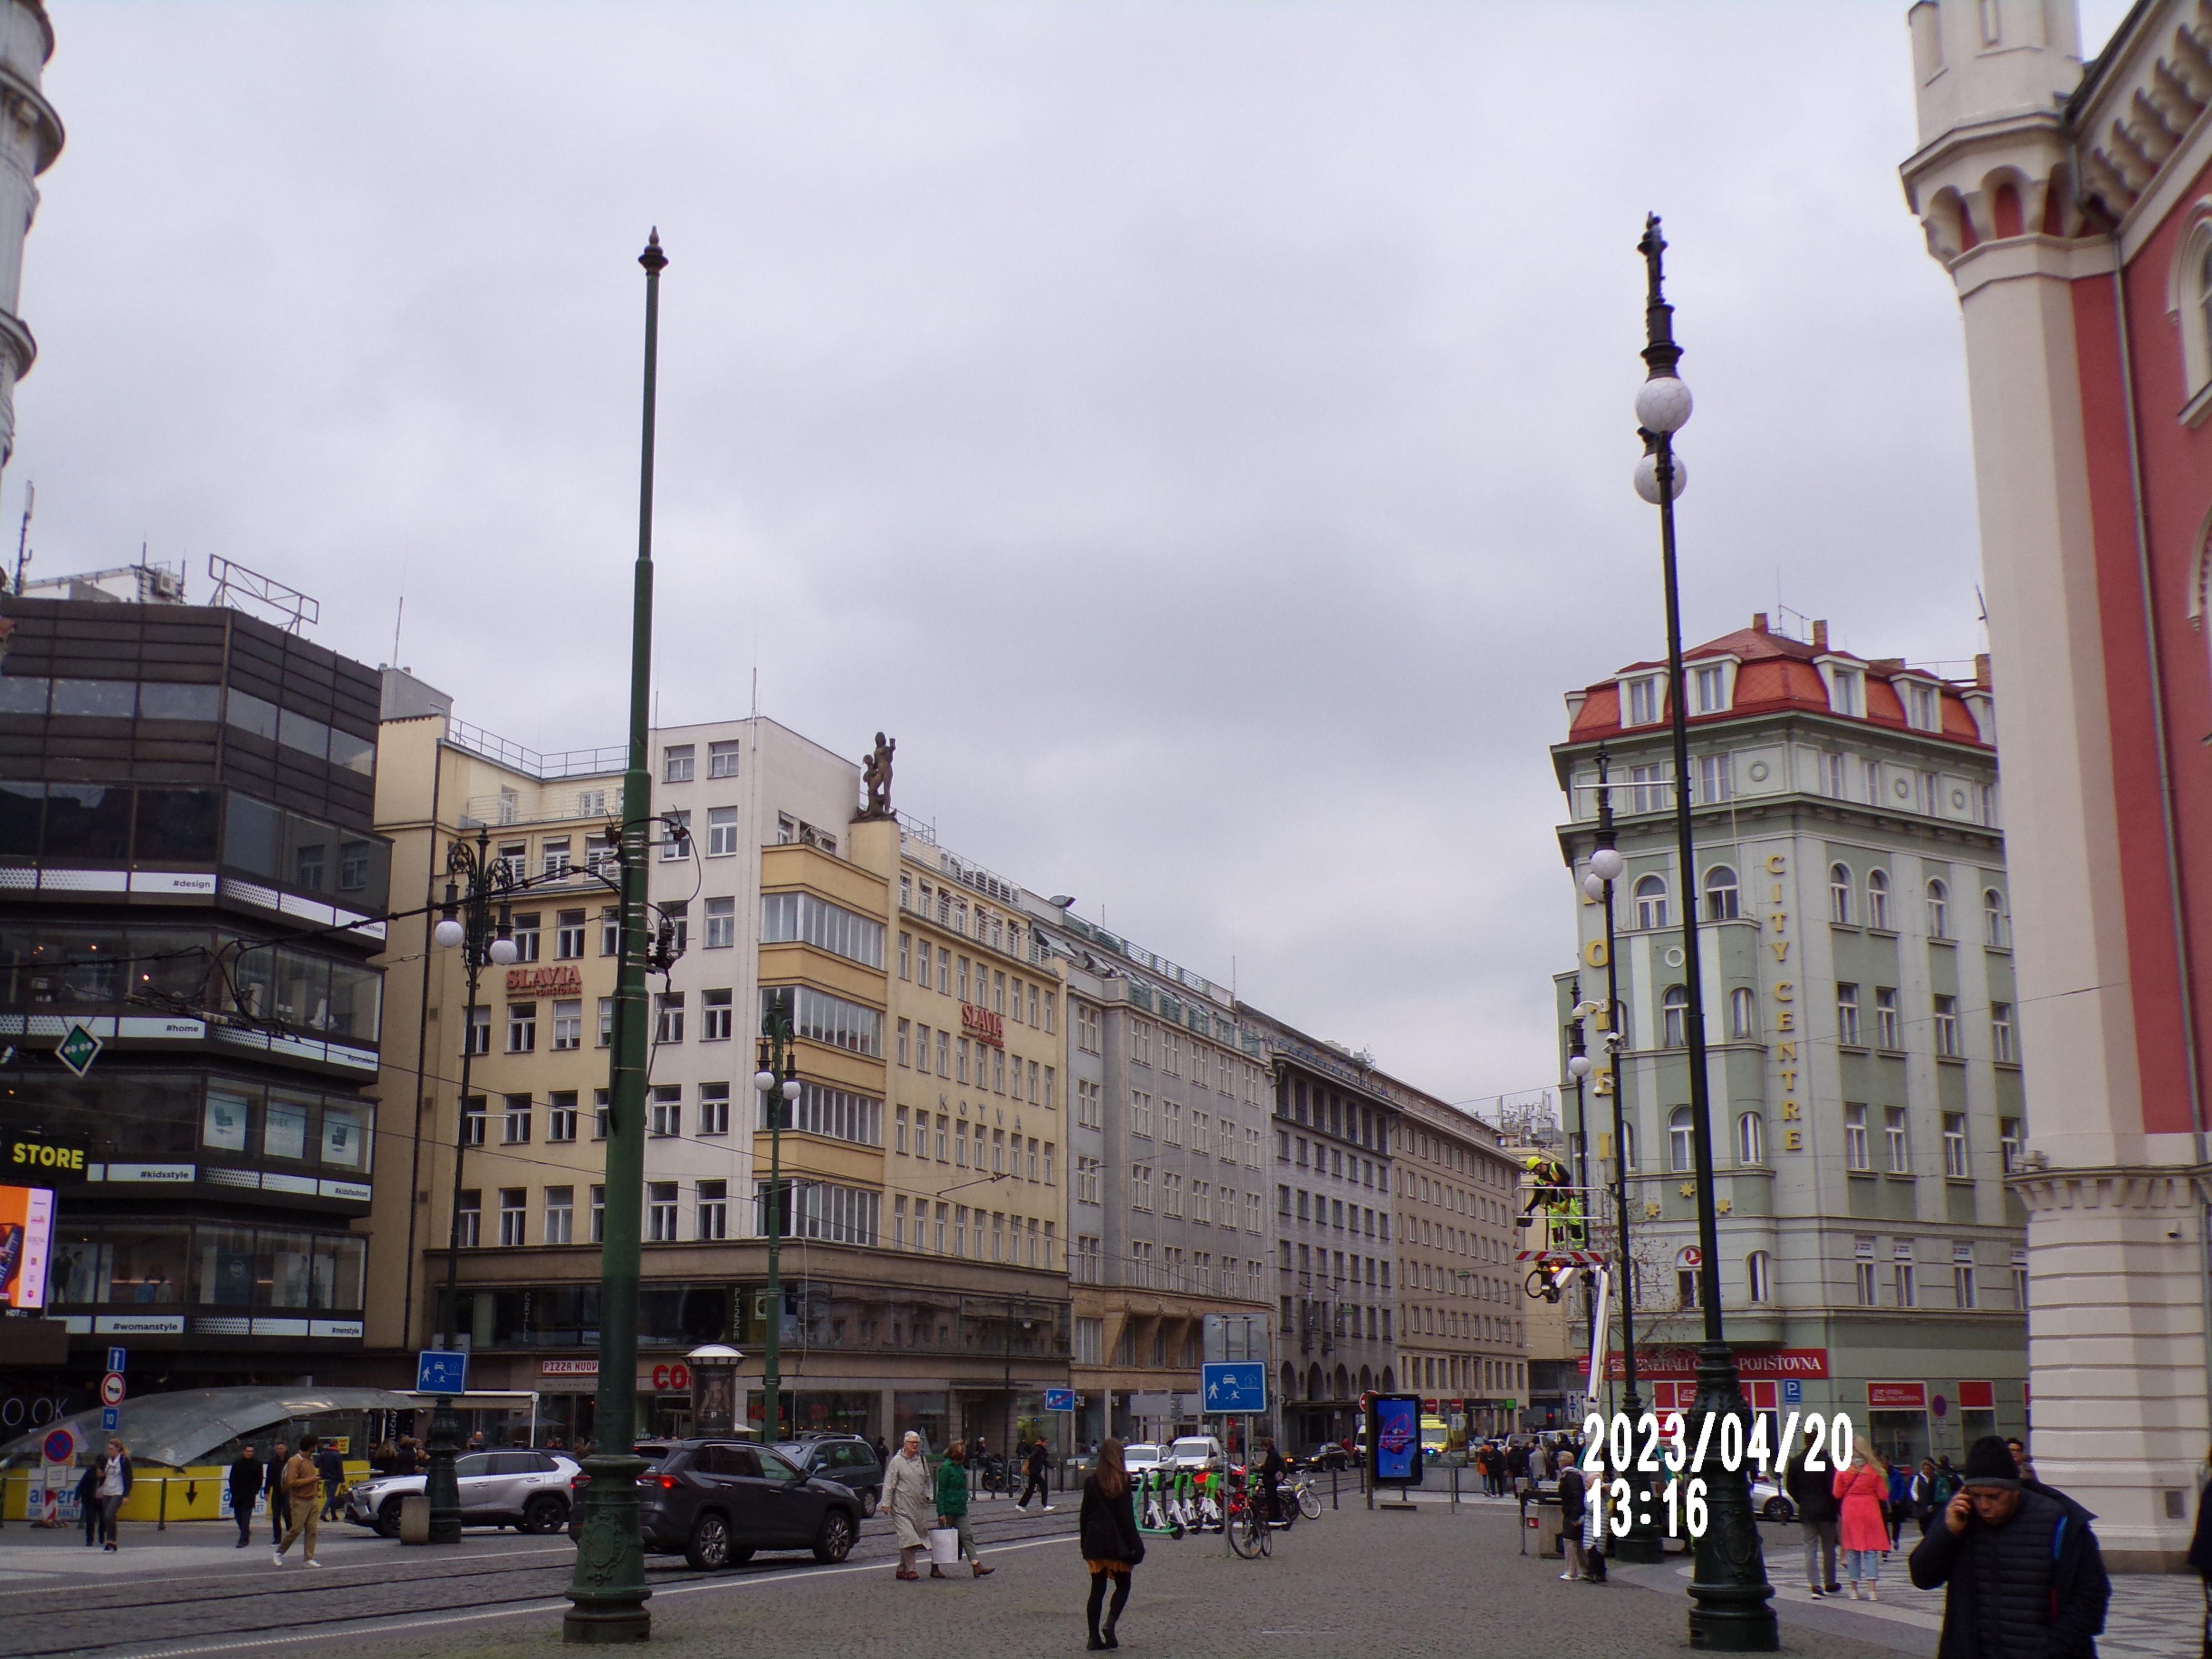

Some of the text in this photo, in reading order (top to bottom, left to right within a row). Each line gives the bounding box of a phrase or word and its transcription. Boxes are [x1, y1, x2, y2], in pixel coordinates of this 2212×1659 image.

[173, 880, 210, 889] #design
[506, 965, 582, 989] SLAVIA
[1767, 854, 1803, 1150] CITY CENTRE
[962, 1003, 1004, 1037] SLAVIA
[939, 1093, 1021, 1130] KOTVA
[13, 1142, 85, 1169] STORE
[140, 1171, 189, 1180] #kidsstyle
[113, 1323, 178, 1332] #womanstyle
[544, 1362, 598, 1371] PIZZA NUOV
[1739, 1355, 1822, 1371] POJIŠŤOVNA
[653, 1365, 691, 1389] CO
